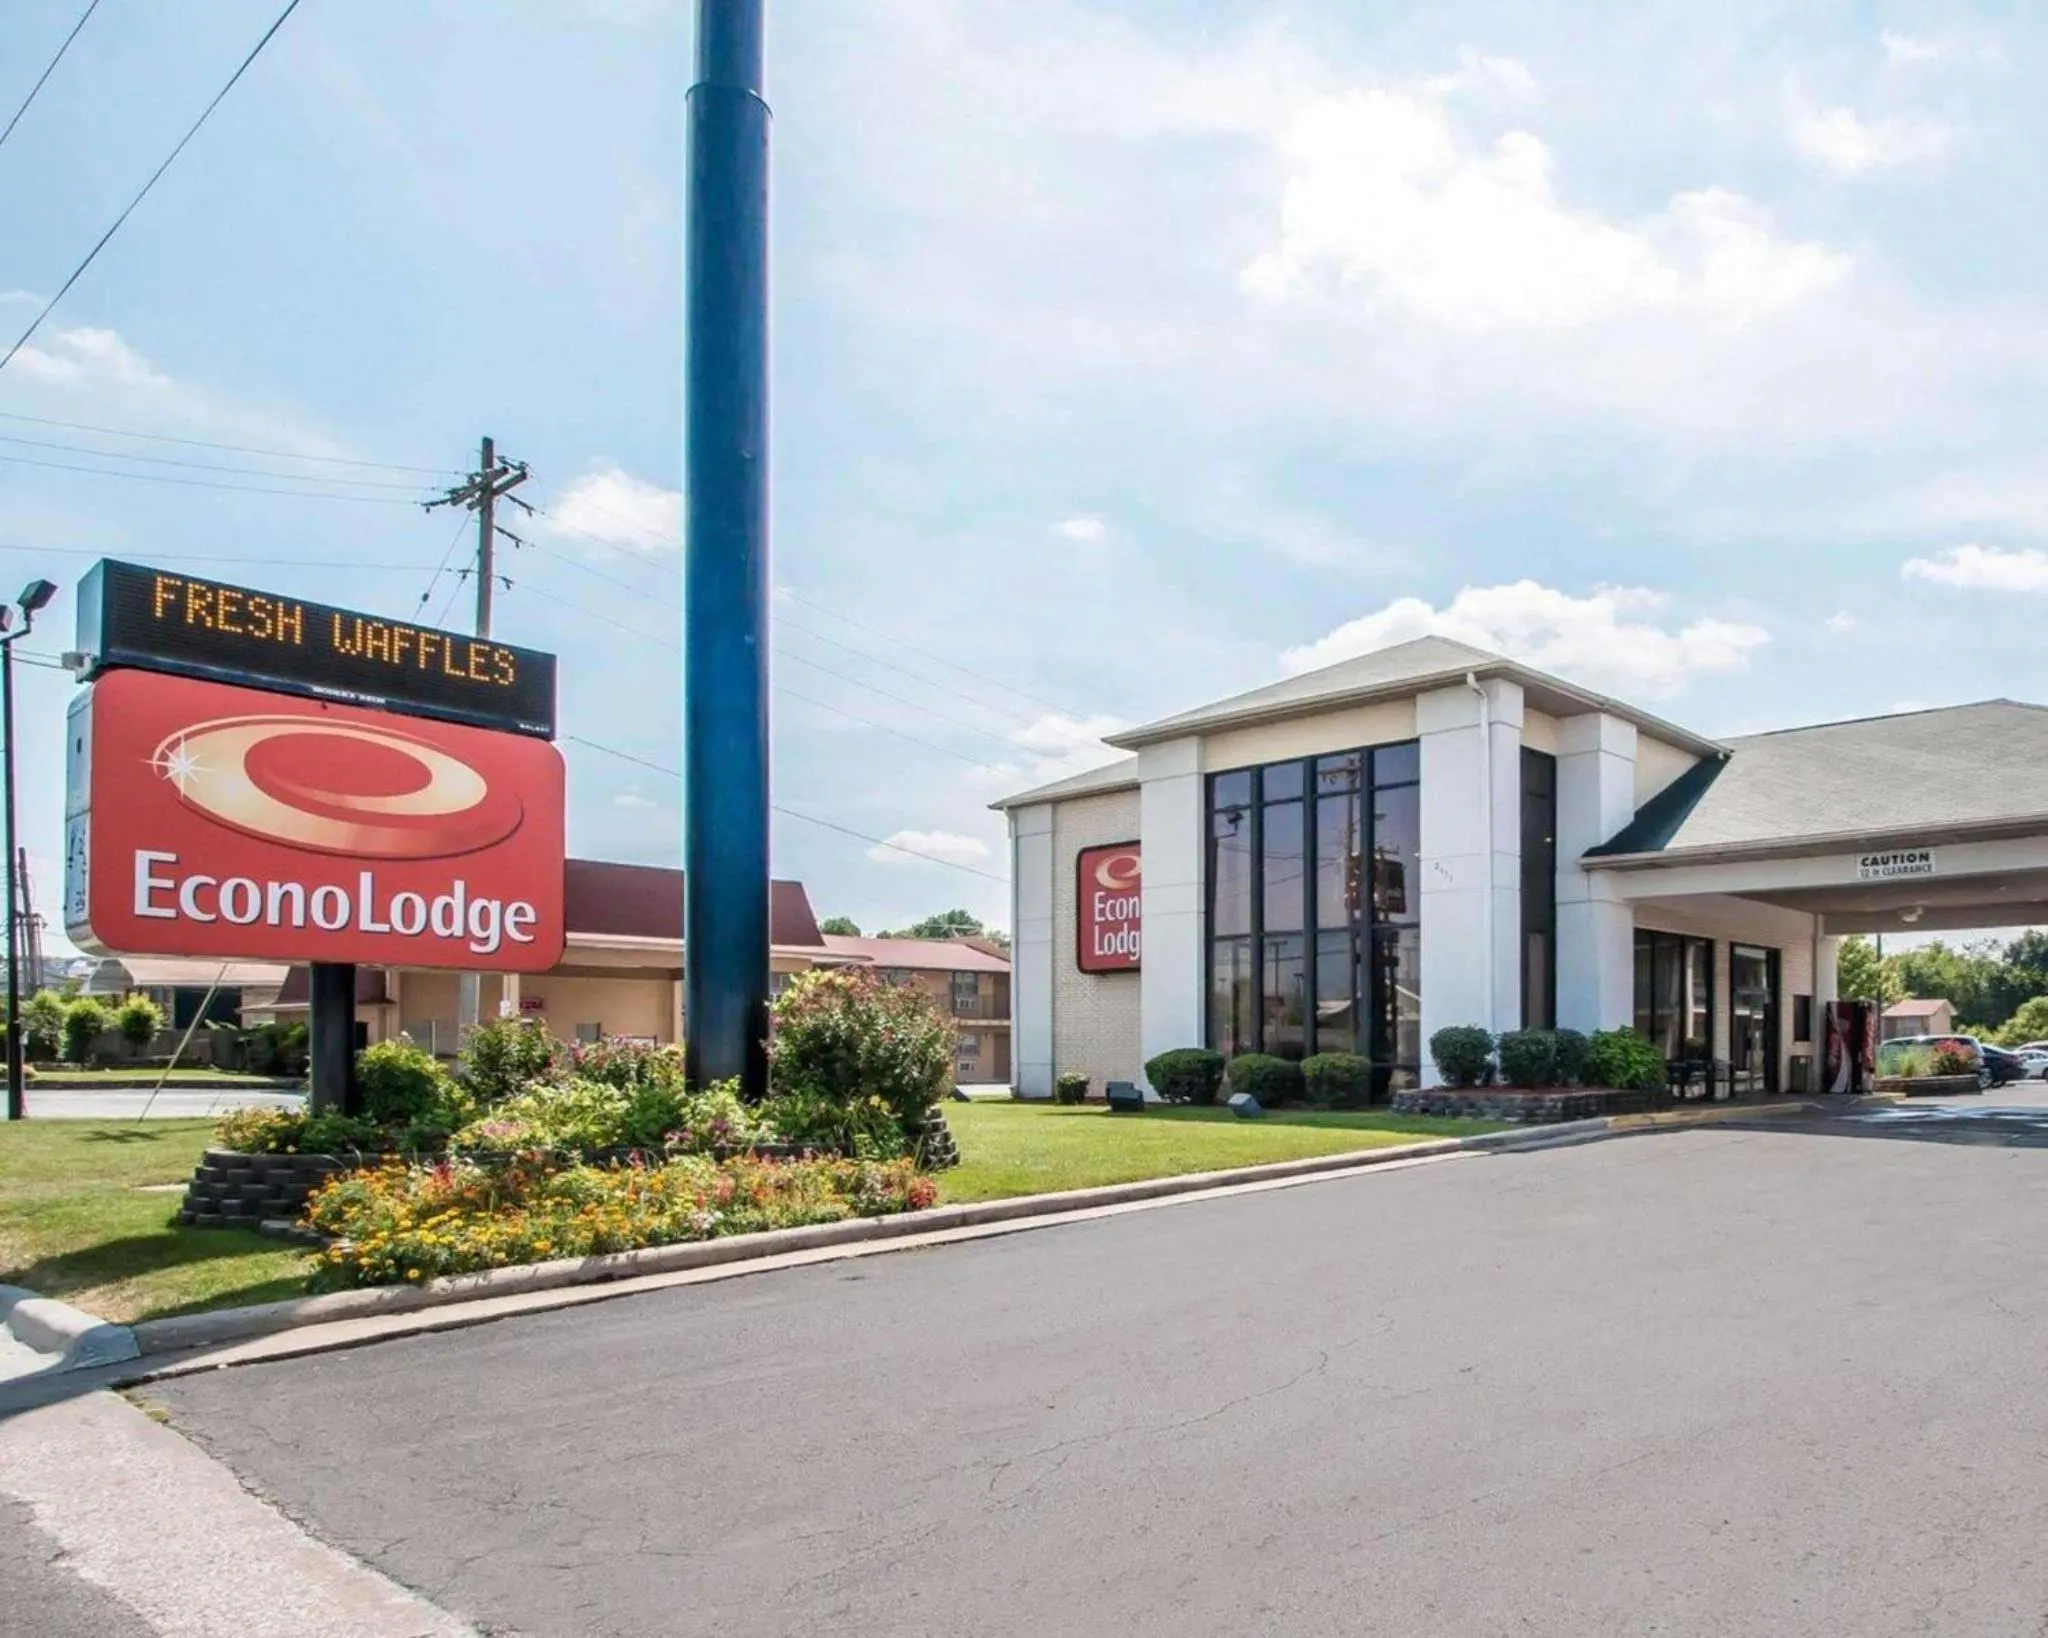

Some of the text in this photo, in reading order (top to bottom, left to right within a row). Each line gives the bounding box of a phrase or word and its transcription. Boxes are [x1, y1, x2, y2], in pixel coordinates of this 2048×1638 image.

[154, 575, 515, 686] FRESH WAFFLES
[1861, 852, 1930, 867] CAUTION
[133, 849, 537, 953] EconoLodge
[1094, 891, 1140, 921] Econ
[1094, 922, 1141, 961] Lodg
